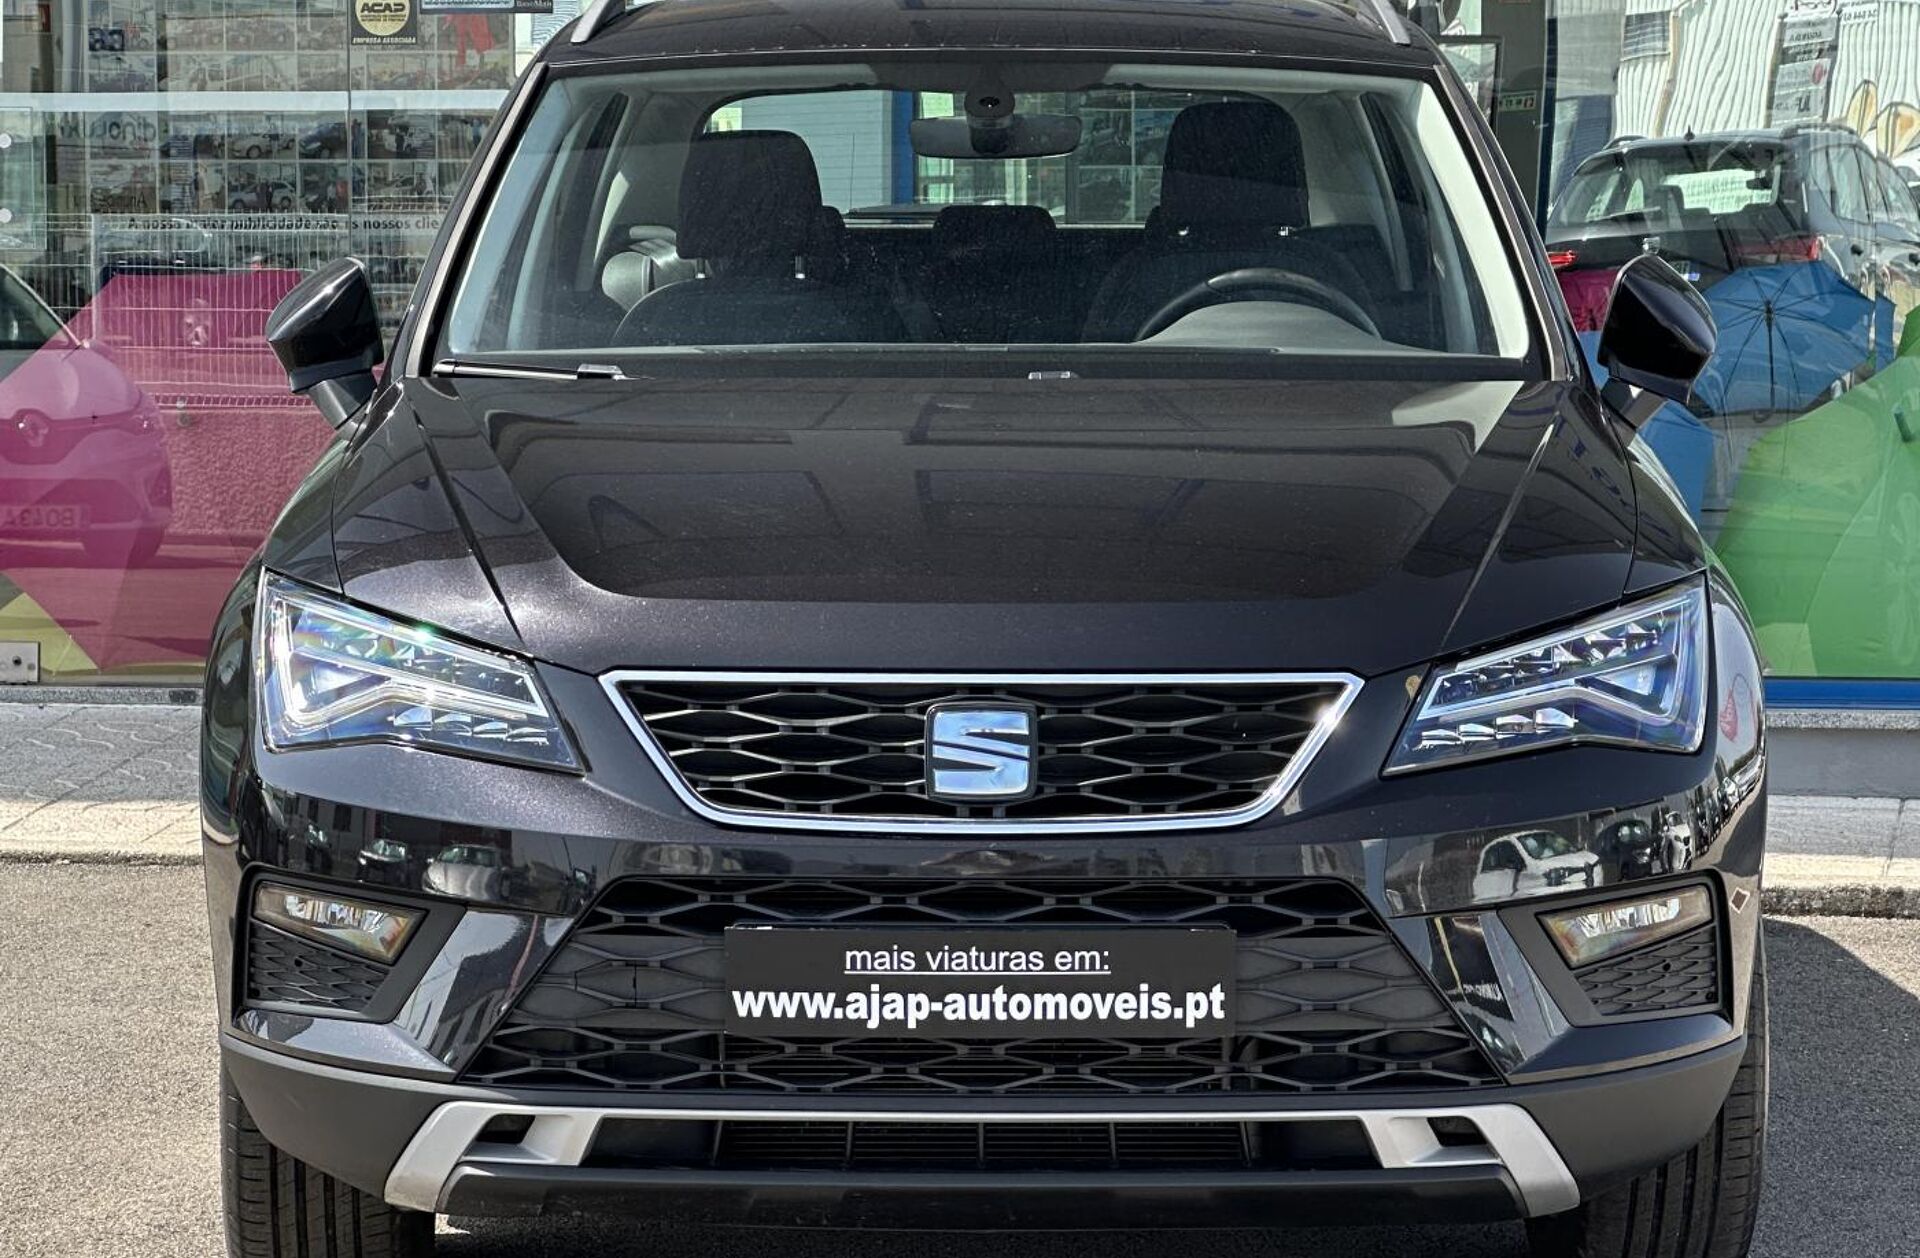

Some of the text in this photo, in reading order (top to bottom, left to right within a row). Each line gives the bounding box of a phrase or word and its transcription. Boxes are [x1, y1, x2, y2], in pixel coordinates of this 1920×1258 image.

[230, 217, 311, 233] publicidade
[363, 220, 411, 230] nossos
[845, 946, 1110, 971] mais viaturas em:
[732, 984, 1226, 1029] www.ajap-automoveis.pt
